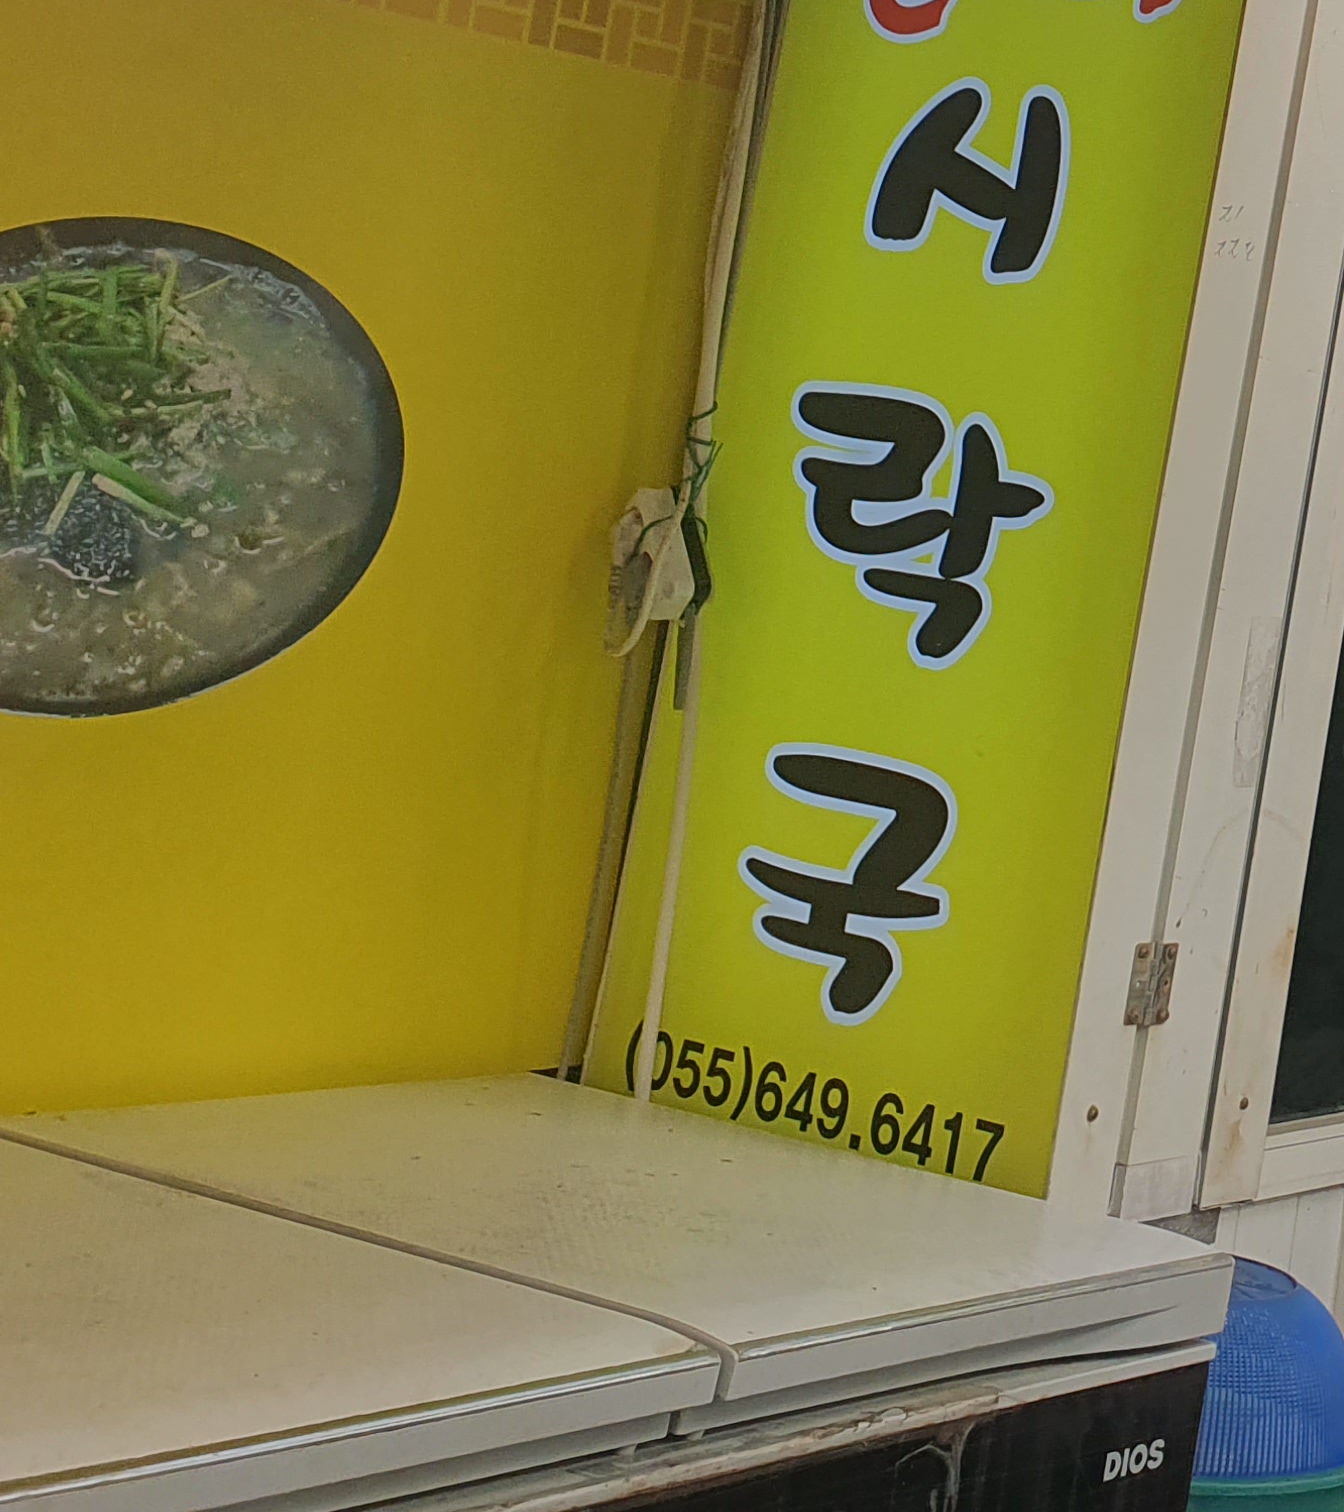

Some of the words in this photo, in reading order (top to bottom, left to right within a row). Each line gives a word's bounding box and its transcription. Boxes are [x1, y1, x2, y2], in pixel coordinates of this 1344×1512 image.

[738, 76, 1070, 1024] 시락국
[625, 1018, 1005, 1182] (055)649.6417
[1102, 1438, 1166, 1483] DIOS
